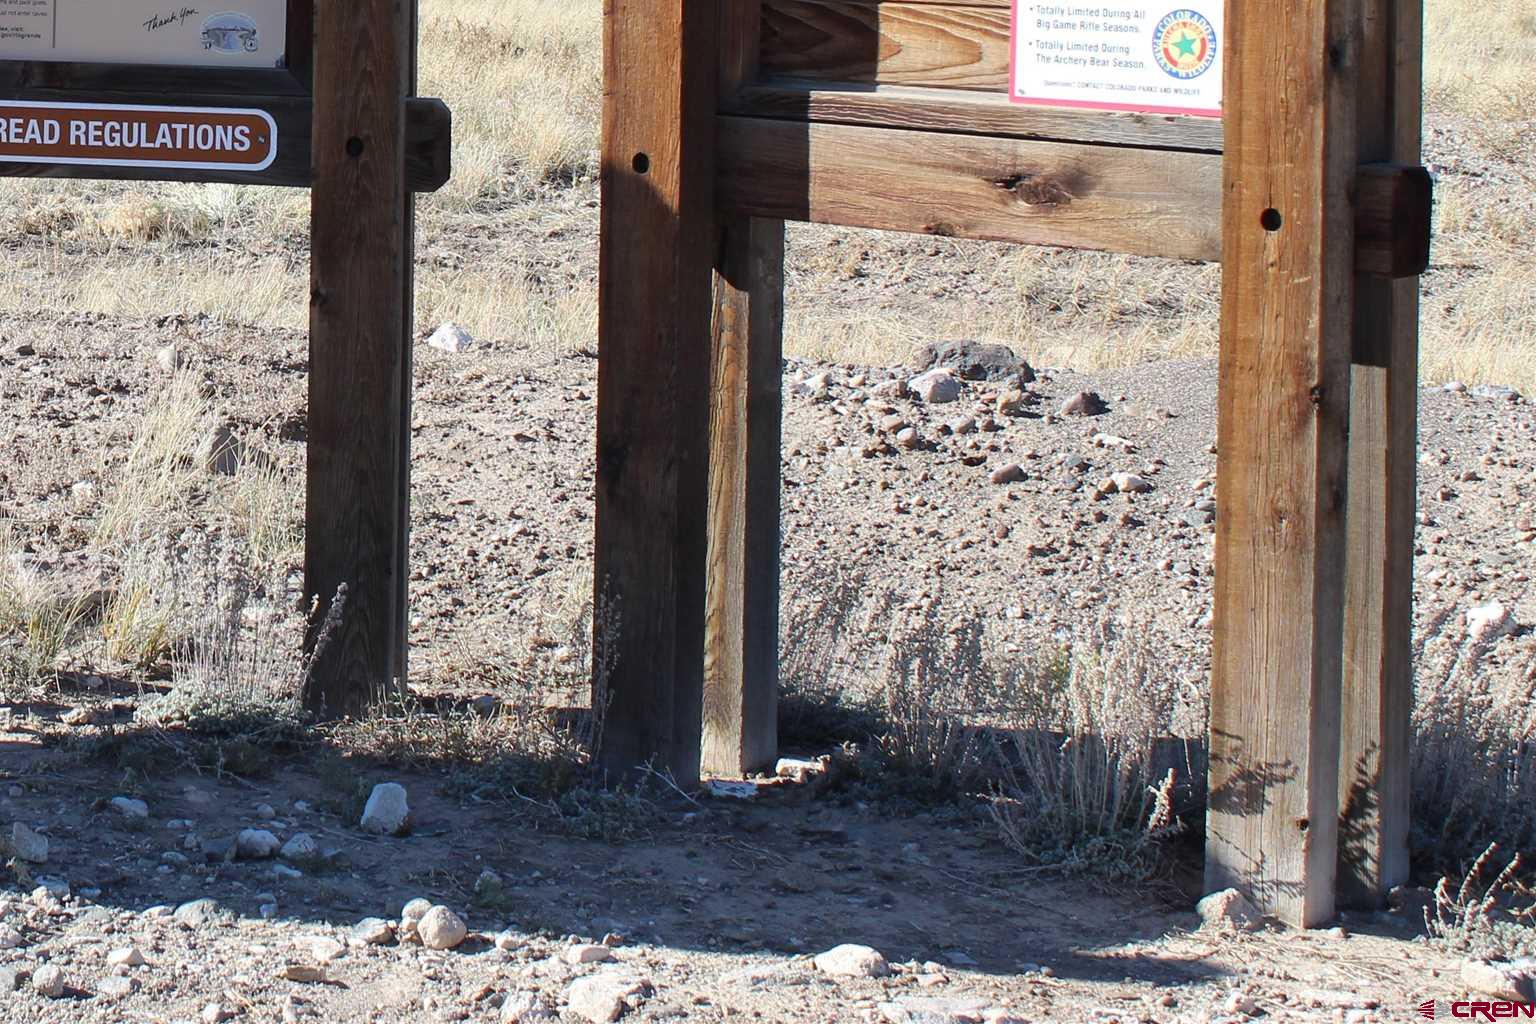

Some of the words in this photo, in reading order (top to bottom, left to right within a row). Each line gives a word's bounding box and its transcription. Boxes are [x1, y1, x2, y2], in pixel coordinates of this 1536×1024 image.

[142, 13, 179, 31] Thank
[180, 7, 200, 25] You
[1035, 5, 1065, 17] Totally
[1067, 6, 1100, 18] Limited
[1102, 8, 1131, 21] During
[1133, 9, 1146, 19] All
[1036, 19, 1050, 31] Big
[1052, 20, 1077, 30] Game
[1079, 21, 1101, 31] Rifle
[1035, 39, 1064, 52] Totally
[1066, 41, 1099, 53] Limited
[1101, 42, 1130, 55] During
[1035, 53, 1051, 64] The
[1053, 54, 1087, 68] Archery
[1089, 56, 1110, 67] Bear
[69, 121, 252, 152] REGULATIONS
